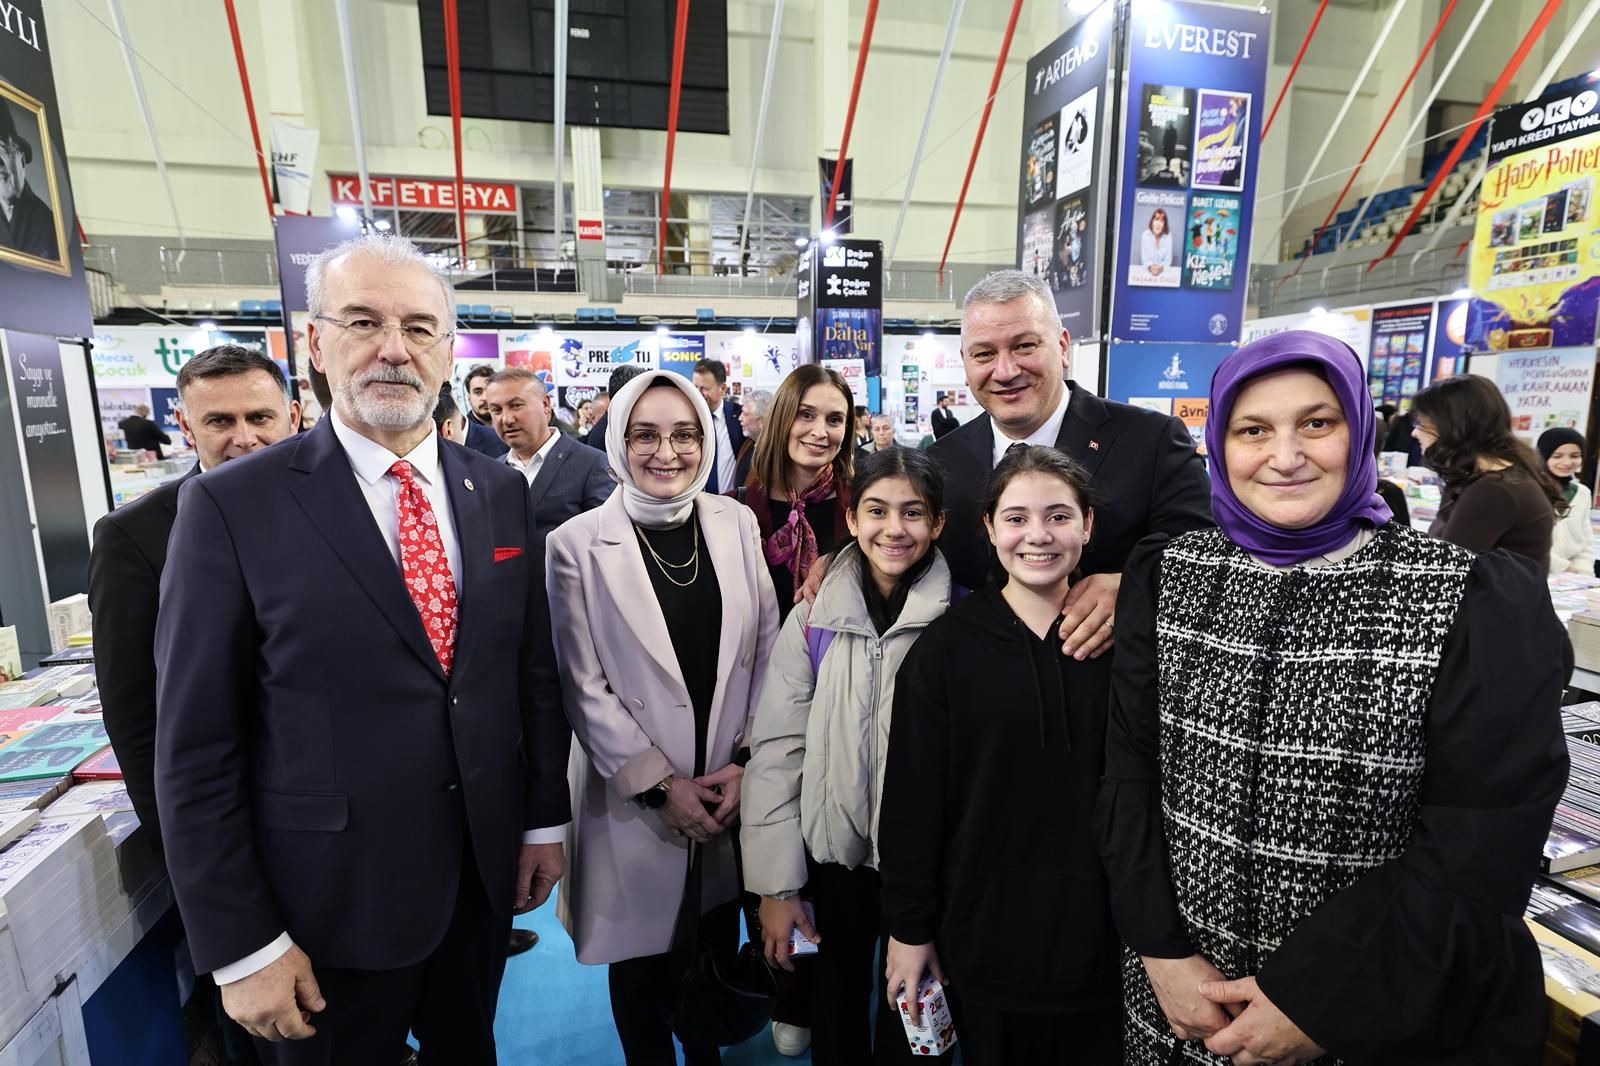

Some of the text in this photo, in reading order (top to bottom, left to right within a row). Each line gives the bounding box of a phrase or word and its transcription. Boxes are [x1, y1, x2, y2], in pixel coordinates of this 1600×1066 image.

[0, 0, 41, 51] YLI
[1491, 141, 1517, 153] YAPI
[1518, 125, 1556, 146] KREDİ
[1493, 160, 1544, 198] Harry
[336, 180, 510, 209] KAFETERYA
[847, 249, 874, 260] Doğan
[847, 258, 869, 269] Kitap
[843, 279, 870, 289] Doğan
[843, 287, 868, 297] Çocuk
[825, 326, 867, 341] Daha
[663, 351, 702, 362] SONIC
[1521, 381, 1588, 393] KAHRAMAN
[1517, 395, 1551, 407] YATAR
